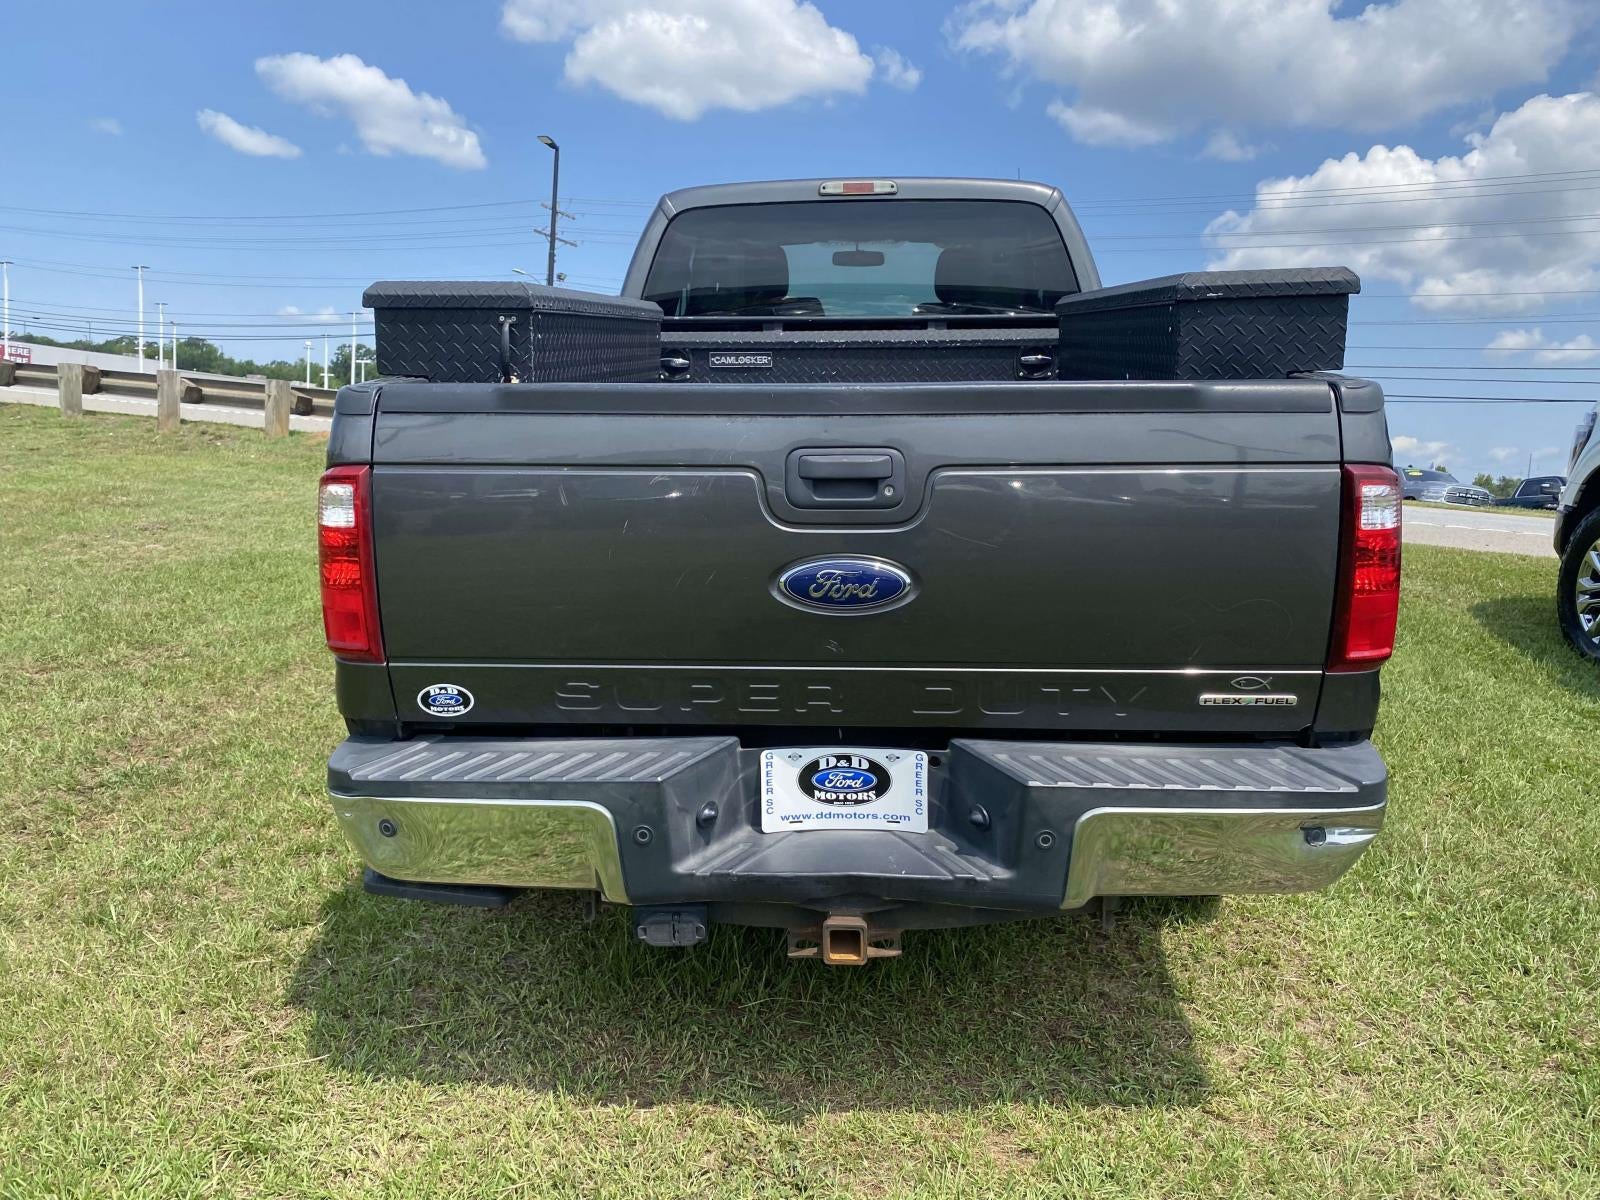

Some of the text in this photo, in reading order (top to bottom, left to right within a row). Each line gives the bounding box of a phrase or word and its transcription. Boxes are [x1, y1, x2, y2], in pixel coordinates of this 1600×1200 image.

[809, 569, 880, 599] Ford
[430, 687, 458, 696] D&D
[555, 677, 1149, 716] SUPER DUTY
[435, 696, 456, 704] Ford
[817, 756, 870, 770] D&D
[824, 771, 864, 788] Ford
[813, 790, 877, 800] MOTORS
[780, 811, 911, 822] www.ddmotors.com
